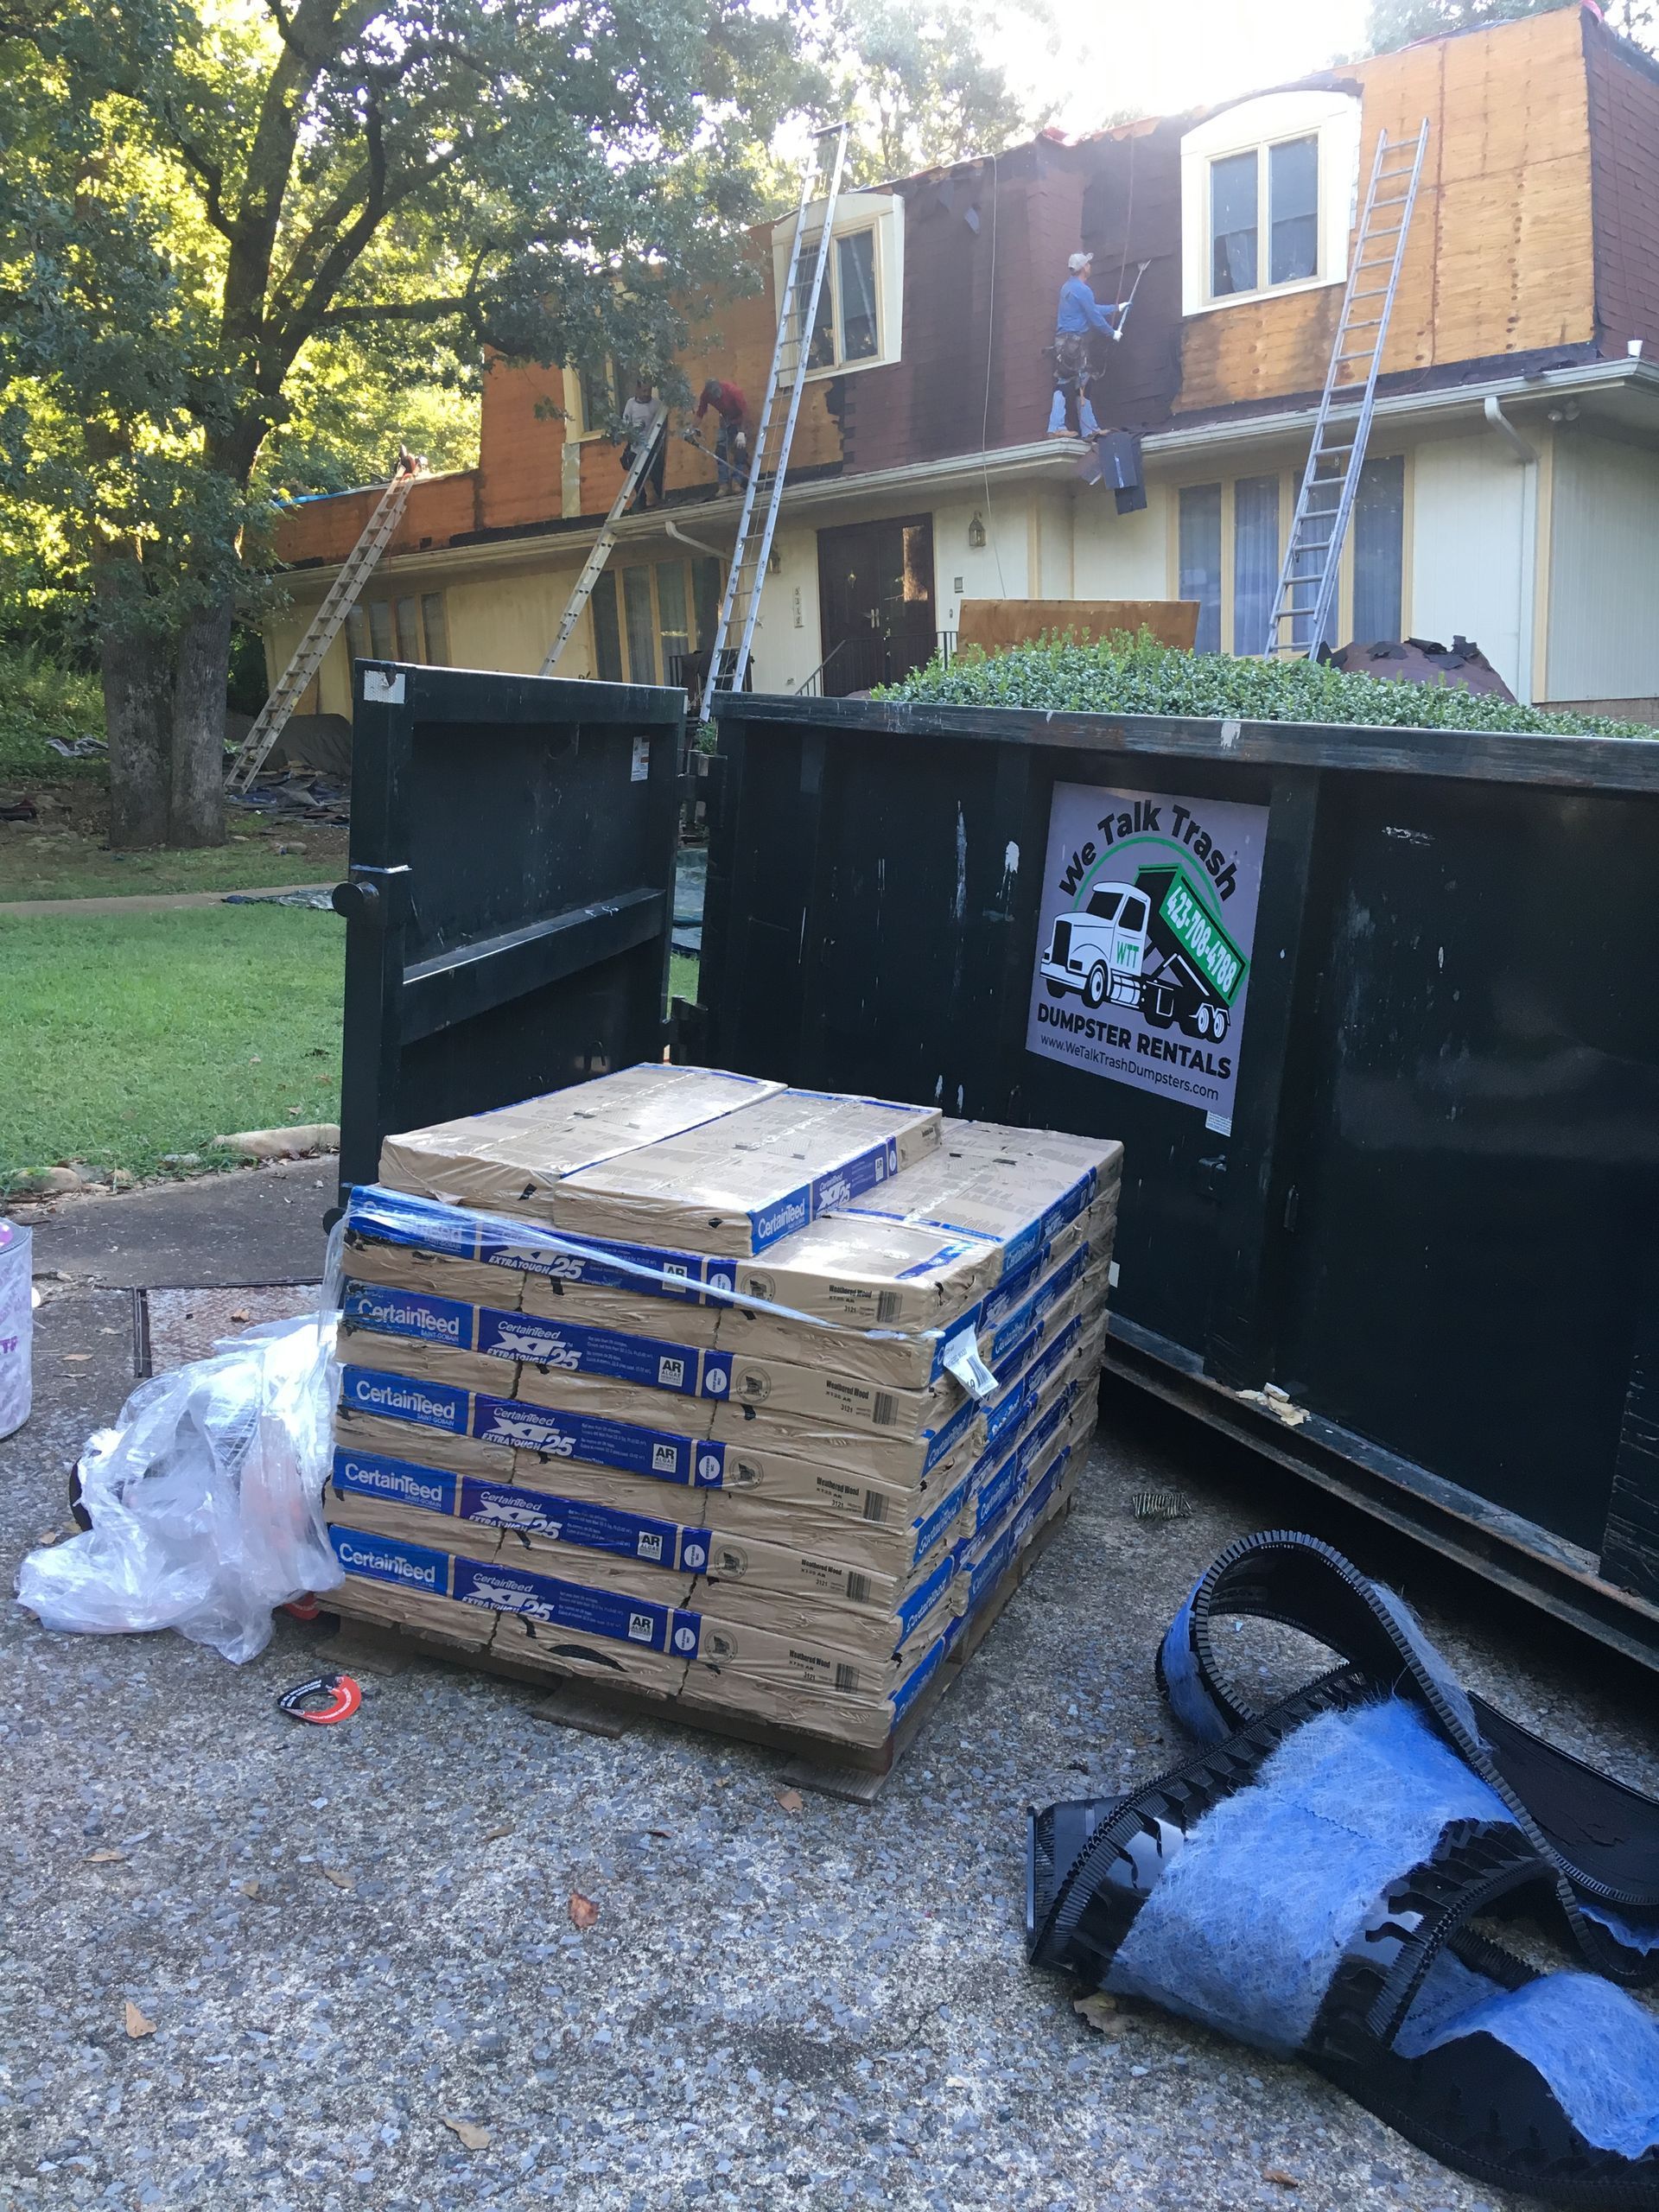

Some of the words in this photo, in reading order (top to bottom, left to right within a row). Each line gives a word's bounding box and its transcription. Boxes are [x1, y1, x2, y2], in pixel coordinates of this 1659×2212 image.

[1058, 842, 1096, 896] We
[1097, 799, 1161, 845] Talk
[1172, 804, 1237, 902] Trash
[1166, 886, 1237, 993] 423-708-4788
[1116, 941, 1140, 969] WTT
[1038, 1002, 1132, 1050] DUMPSTER
[1136, 1033, 1231, 1079] RENTALS
[1040, 1034, 1219, 1101] www.WeTalkTrashDumpsters.com
[838, 1183, 851, 1206] 25
[758, 1198, 805, 1238] CertainTeed
[488, 1255, 550, 1274] EXTRATOUGH
[549, 1257, 587, 1280] 25
[357, 1299, 460, 1335] CertainTeed
[498, 1320, 561, 1339] CertainTeed
[491, 1331, 567, 1357] XT
[546, 1348, 582, 1370] 25
[662, 1359, 682, 1373] AR
[826, 1379, 854, 1395] Weathered
[854, 1387, 869, 1399] Wood
[356, 1380, 455, 1420] CertainTeed
[840, 1403, 853, 1413] 3121
[416, 1413, 454, 1427] SAINT-GOBAIN
[493, 1407, 556, 1427] CertainTeed
[481, 1433, 542, 1451] EXTRATOUGH
[486, 1417, 560, 1443] XT
[541, 1434, 576, 1456] 25
[656, 1446, 675, 1460] AR
[346, 1463, 442, 1502] CertainTeed
[817, 1477, 844, 1492] Weathered
[844, 1485, 860, 1497] Wood
[480, 1491, 542, 1511] CertainTeed
[831, 1499, 844, 1508] 3121
[474, 1500, 547, 1526] XT
[528, 1518, 563, 1540] 25
[641, 1535, 660, 1548] AR
[340, 1542, 435, 1583] CertainTeed
[802, 1559, 827, 1572] Weathered
[828, 1566, 842, 1576] Wood
[473, 1572, 533, 1592] CertainTeed
[467, 1580, 539, 1608] XT
[519, 1599, 554, 1621] 25
[632, 1616, 651, 1630] AR
[790, 1649, 816, 1664] Weathered
[816, 1657, 830, 1669] Wood
